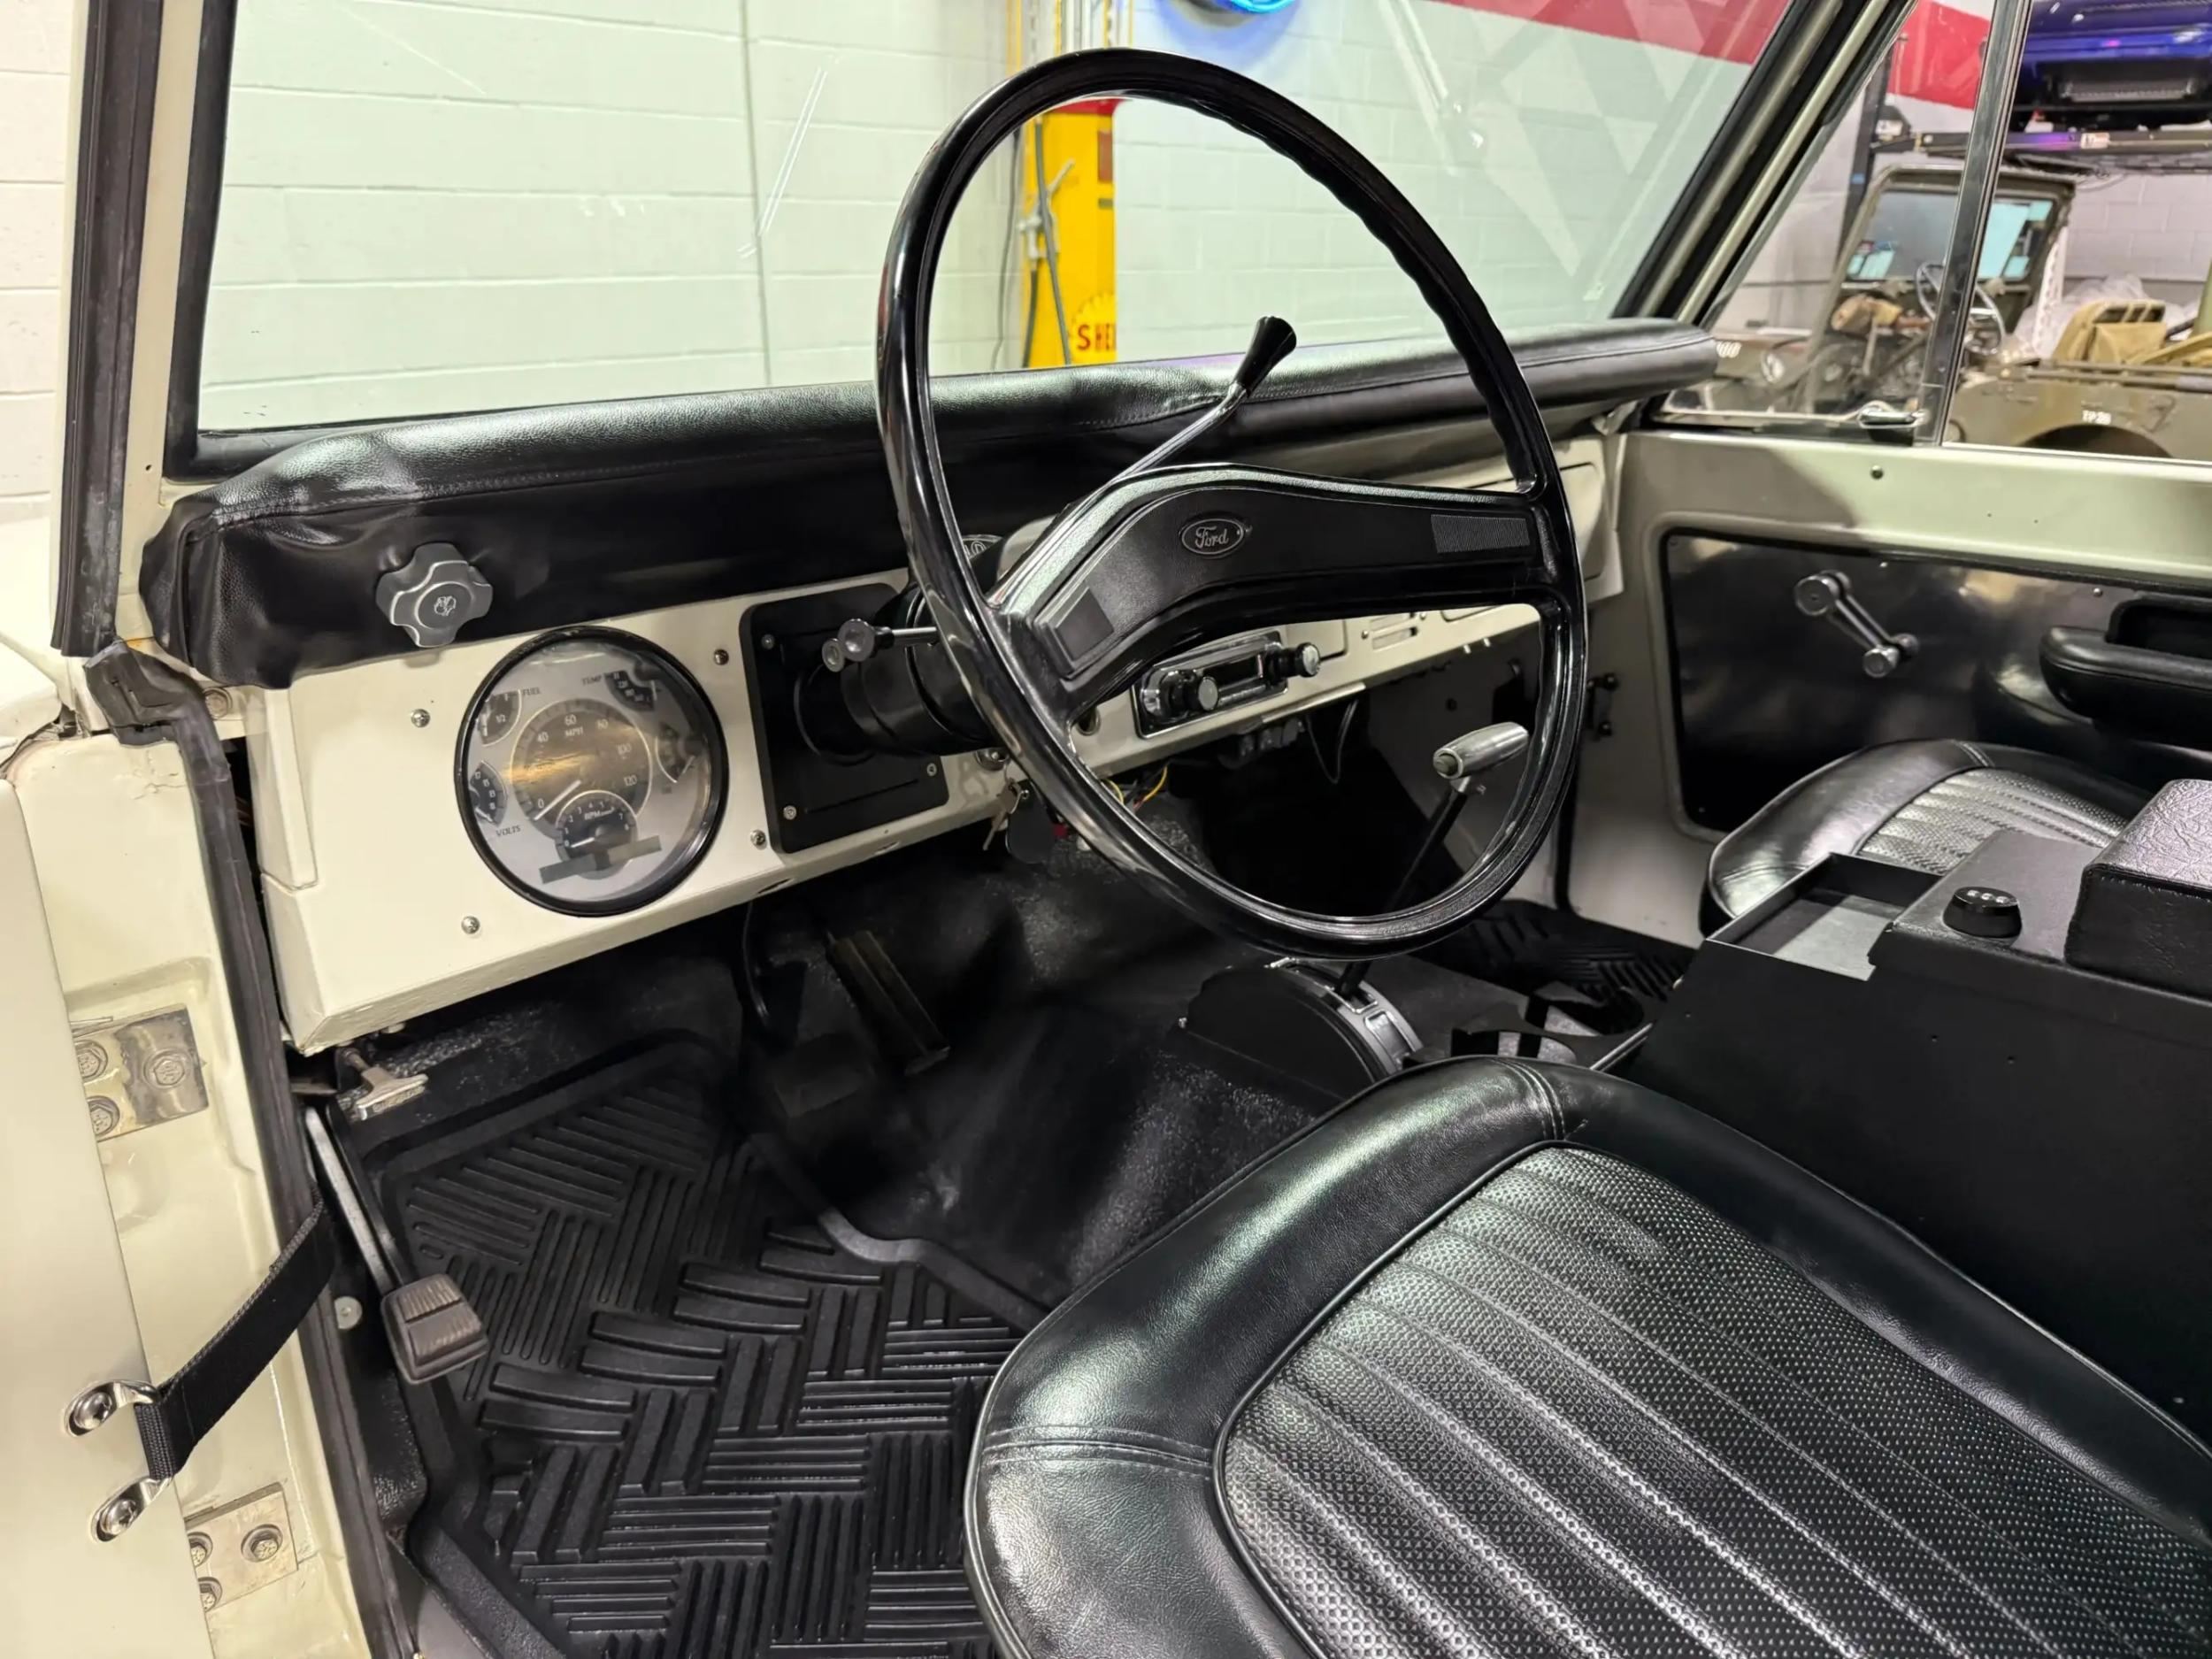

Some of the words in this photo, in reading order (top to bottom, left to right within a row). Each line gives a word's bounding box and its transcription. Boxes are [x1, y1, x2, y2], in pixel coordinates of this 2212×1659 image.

[1195, 526, 1229, 548] Ford
[582, 675, 602, 686] TEMP
[523, 687, 541, 696] FUEL
[565, 714, 576, 726] 60
[537, 732, 549, 742] 40
[624, 775, 637, 787] 120
[538, 798, 544, 809] 0
[496, 825, 521, 837] VOLTS
